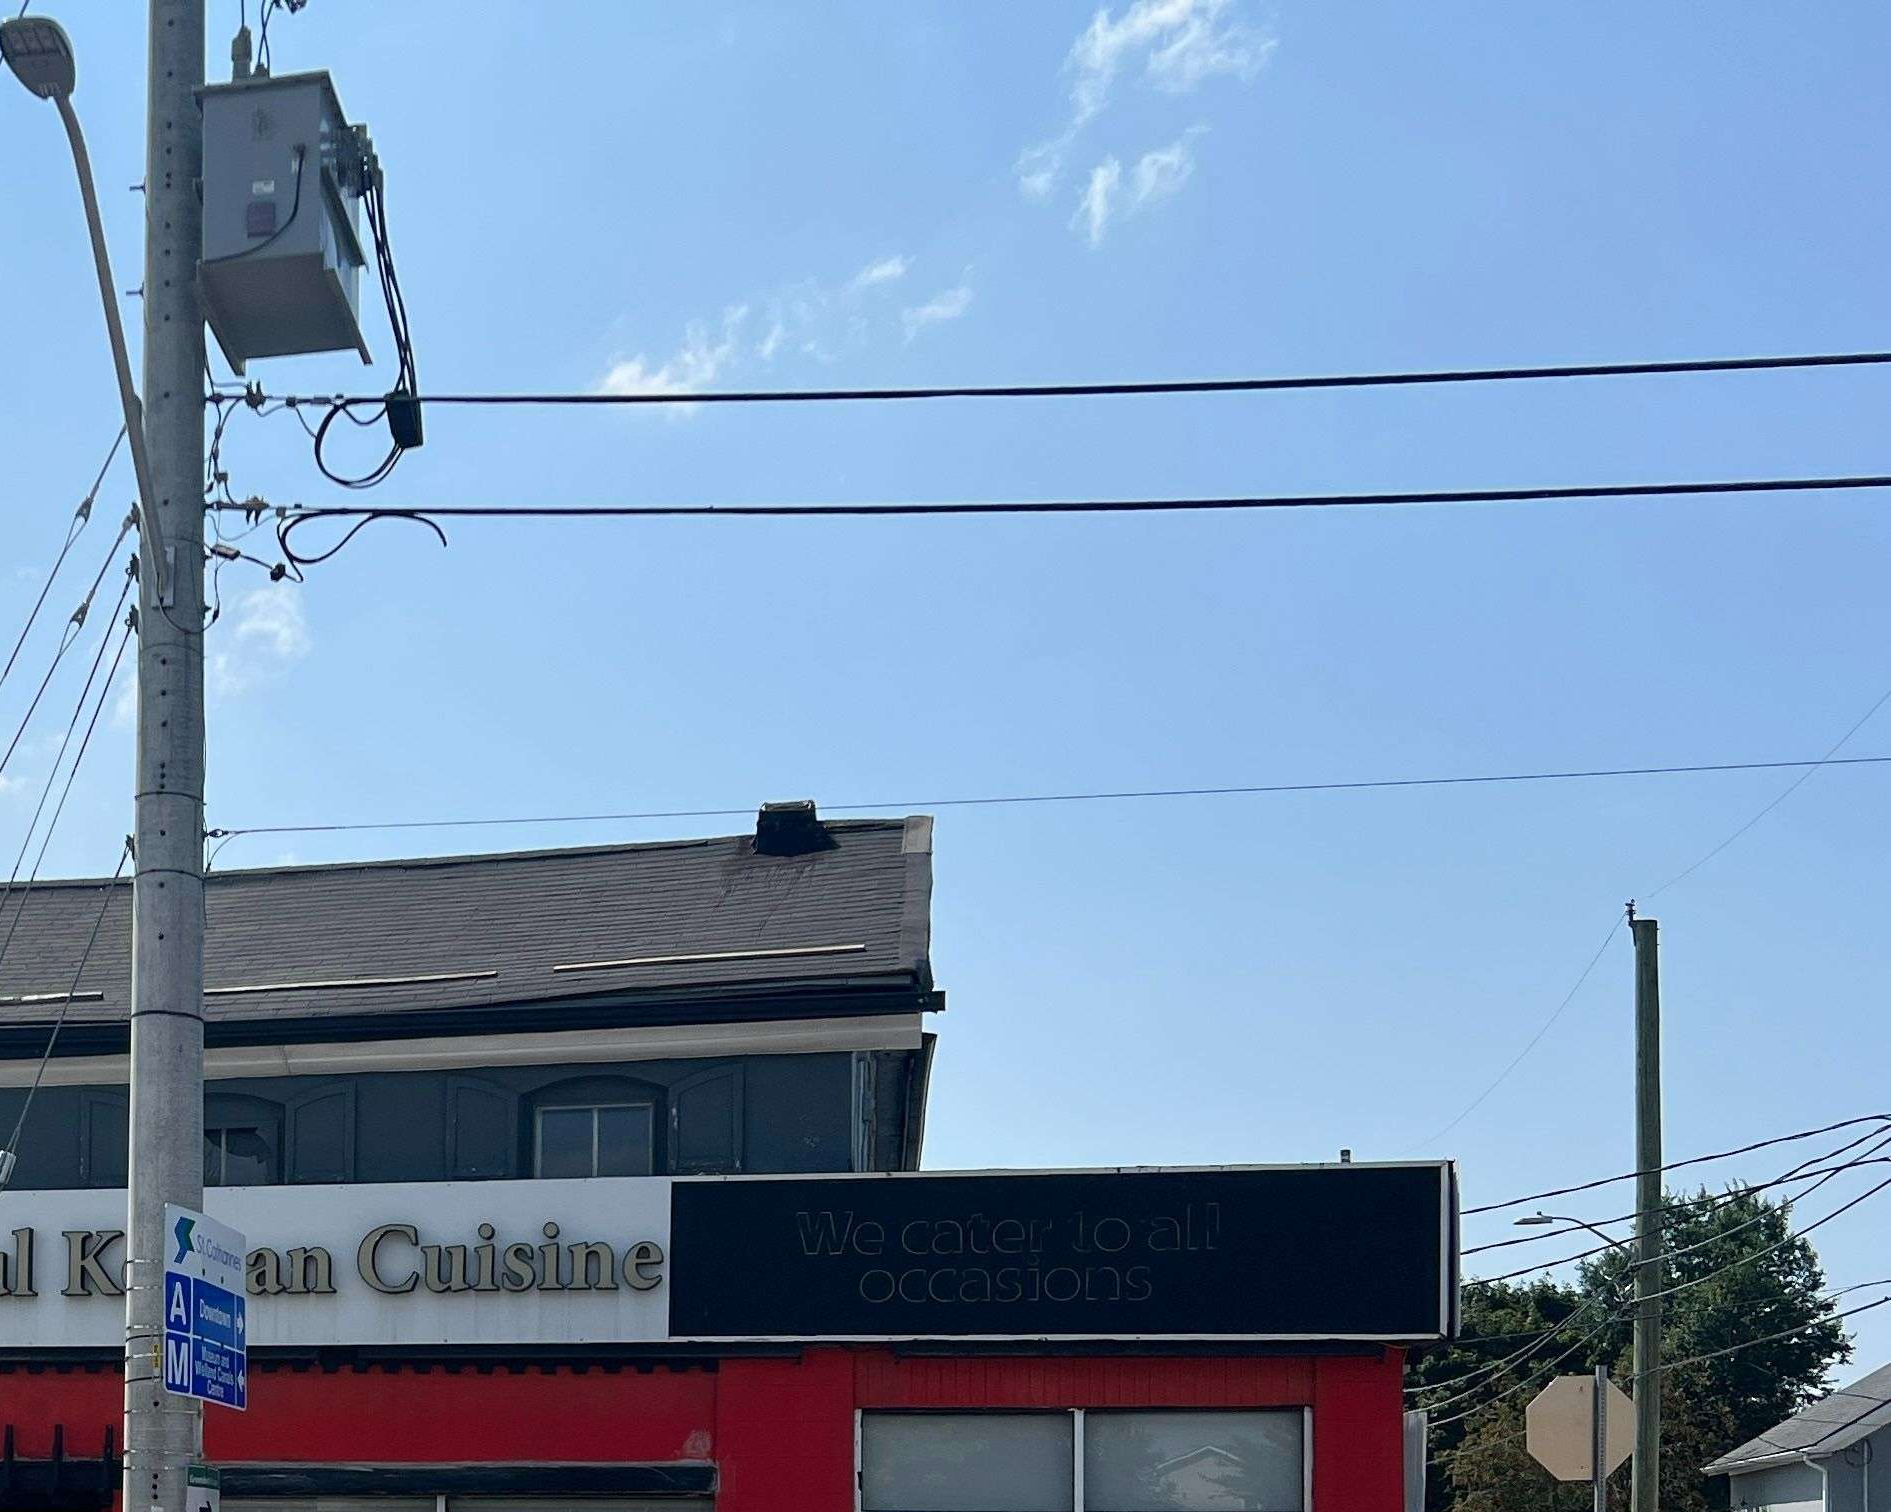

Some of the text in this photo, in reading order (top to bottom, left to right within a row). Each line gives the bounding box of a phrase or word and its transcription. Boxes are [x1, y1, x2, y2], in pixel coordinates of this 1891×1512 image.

[797, 1210, 886, 1256] We
[902, 1212, 1053, 1255] cater
[1147, 1202, 1221, 1252] all
[357, 1220, 665, 1296] Cuisine
[859, 1254, 1154, 1304] occasions
[170, 1281, 187, 1326] A
[168, 1340, 188, 1387] M
